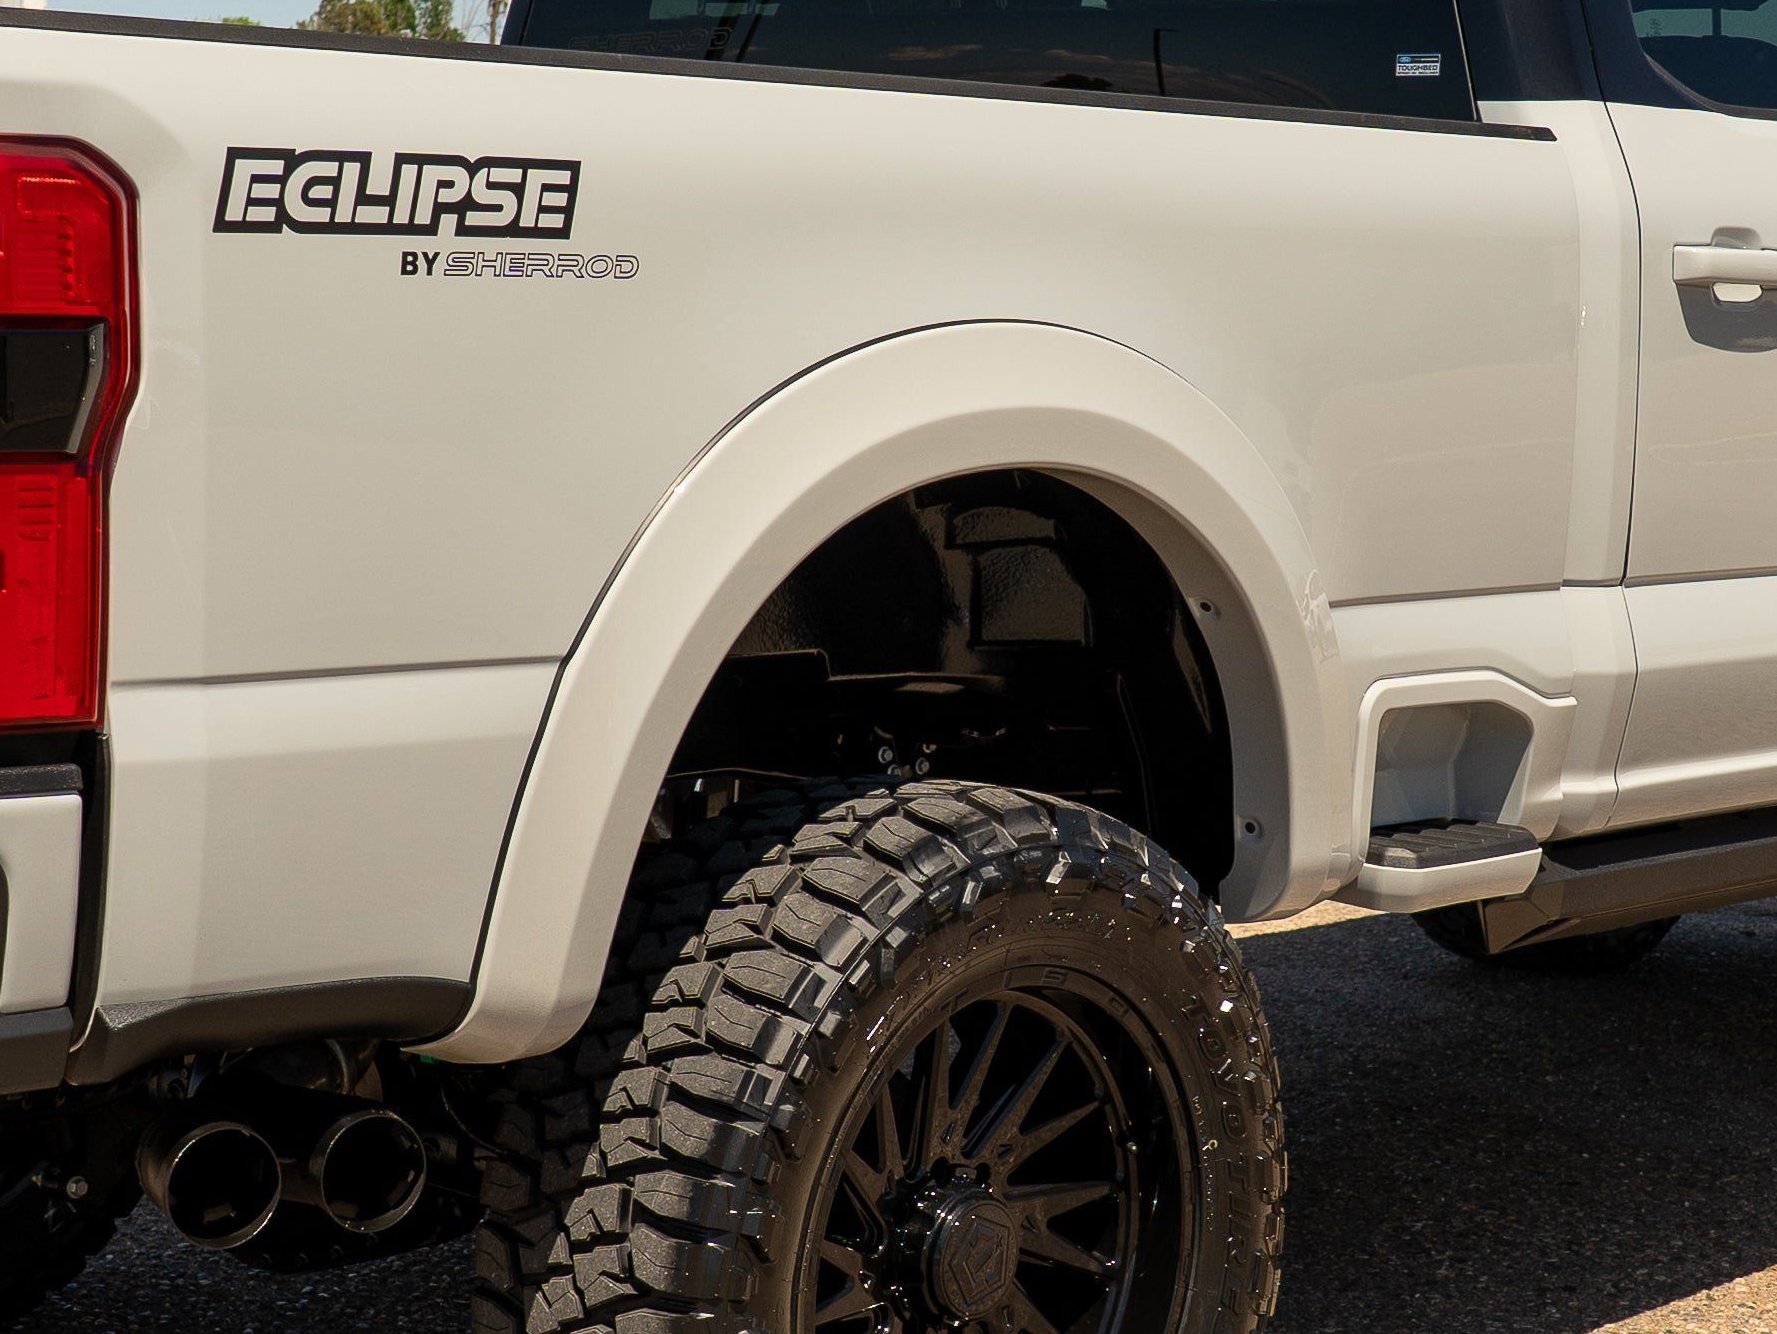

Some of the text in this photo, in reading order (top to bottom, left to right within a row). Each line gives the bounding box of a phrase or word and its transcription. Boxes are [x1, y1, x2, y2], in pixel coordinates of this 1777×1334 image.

[213, 146, 581, 239] ECLIPSE
[400, 250, 640, 279] BY SHERROD
